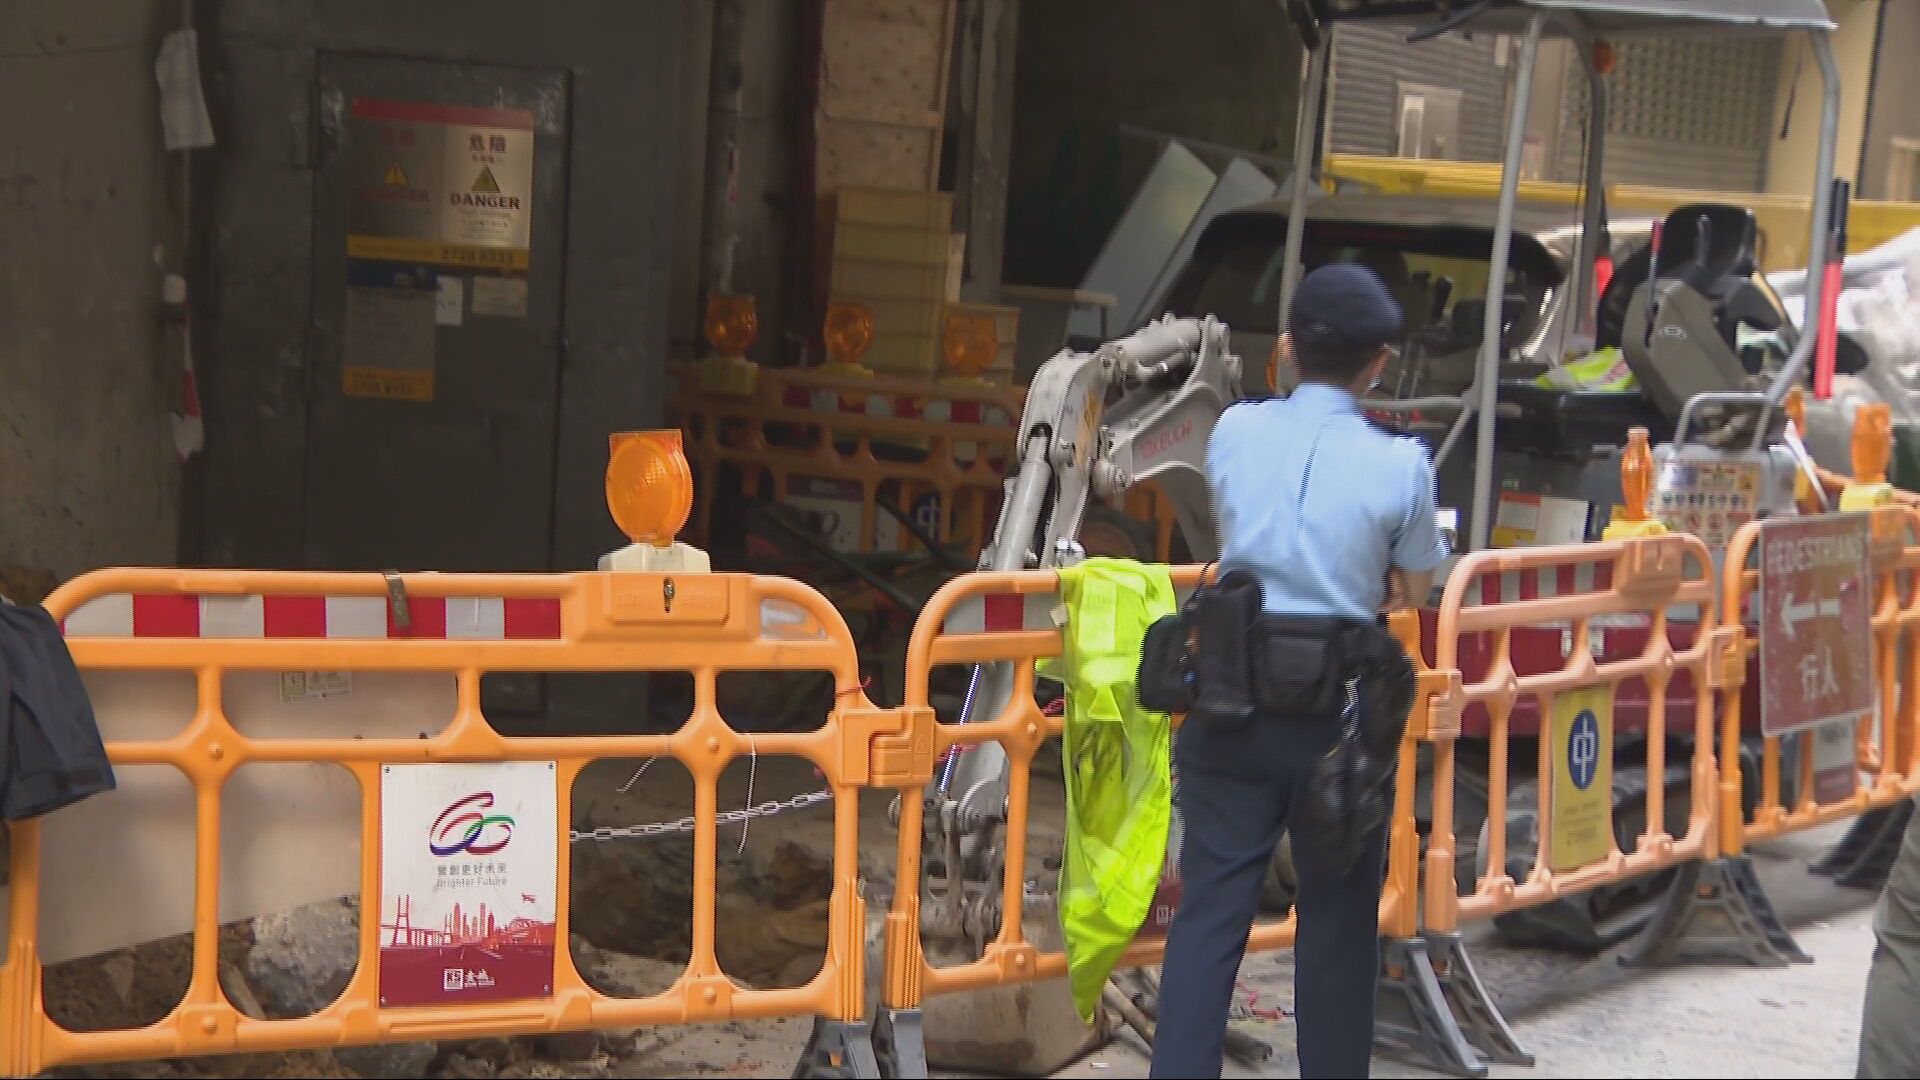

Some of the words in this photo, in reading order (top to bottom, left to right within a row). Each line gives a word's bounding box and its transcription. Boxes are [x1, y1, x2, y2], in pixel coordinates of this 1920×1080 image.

[449, 192, 521, 210] DANGER
[1800, 646, 1840, 700] 行人
[436, 877, 475, 889] Brighter
[477, 876, 508, 887] Future
